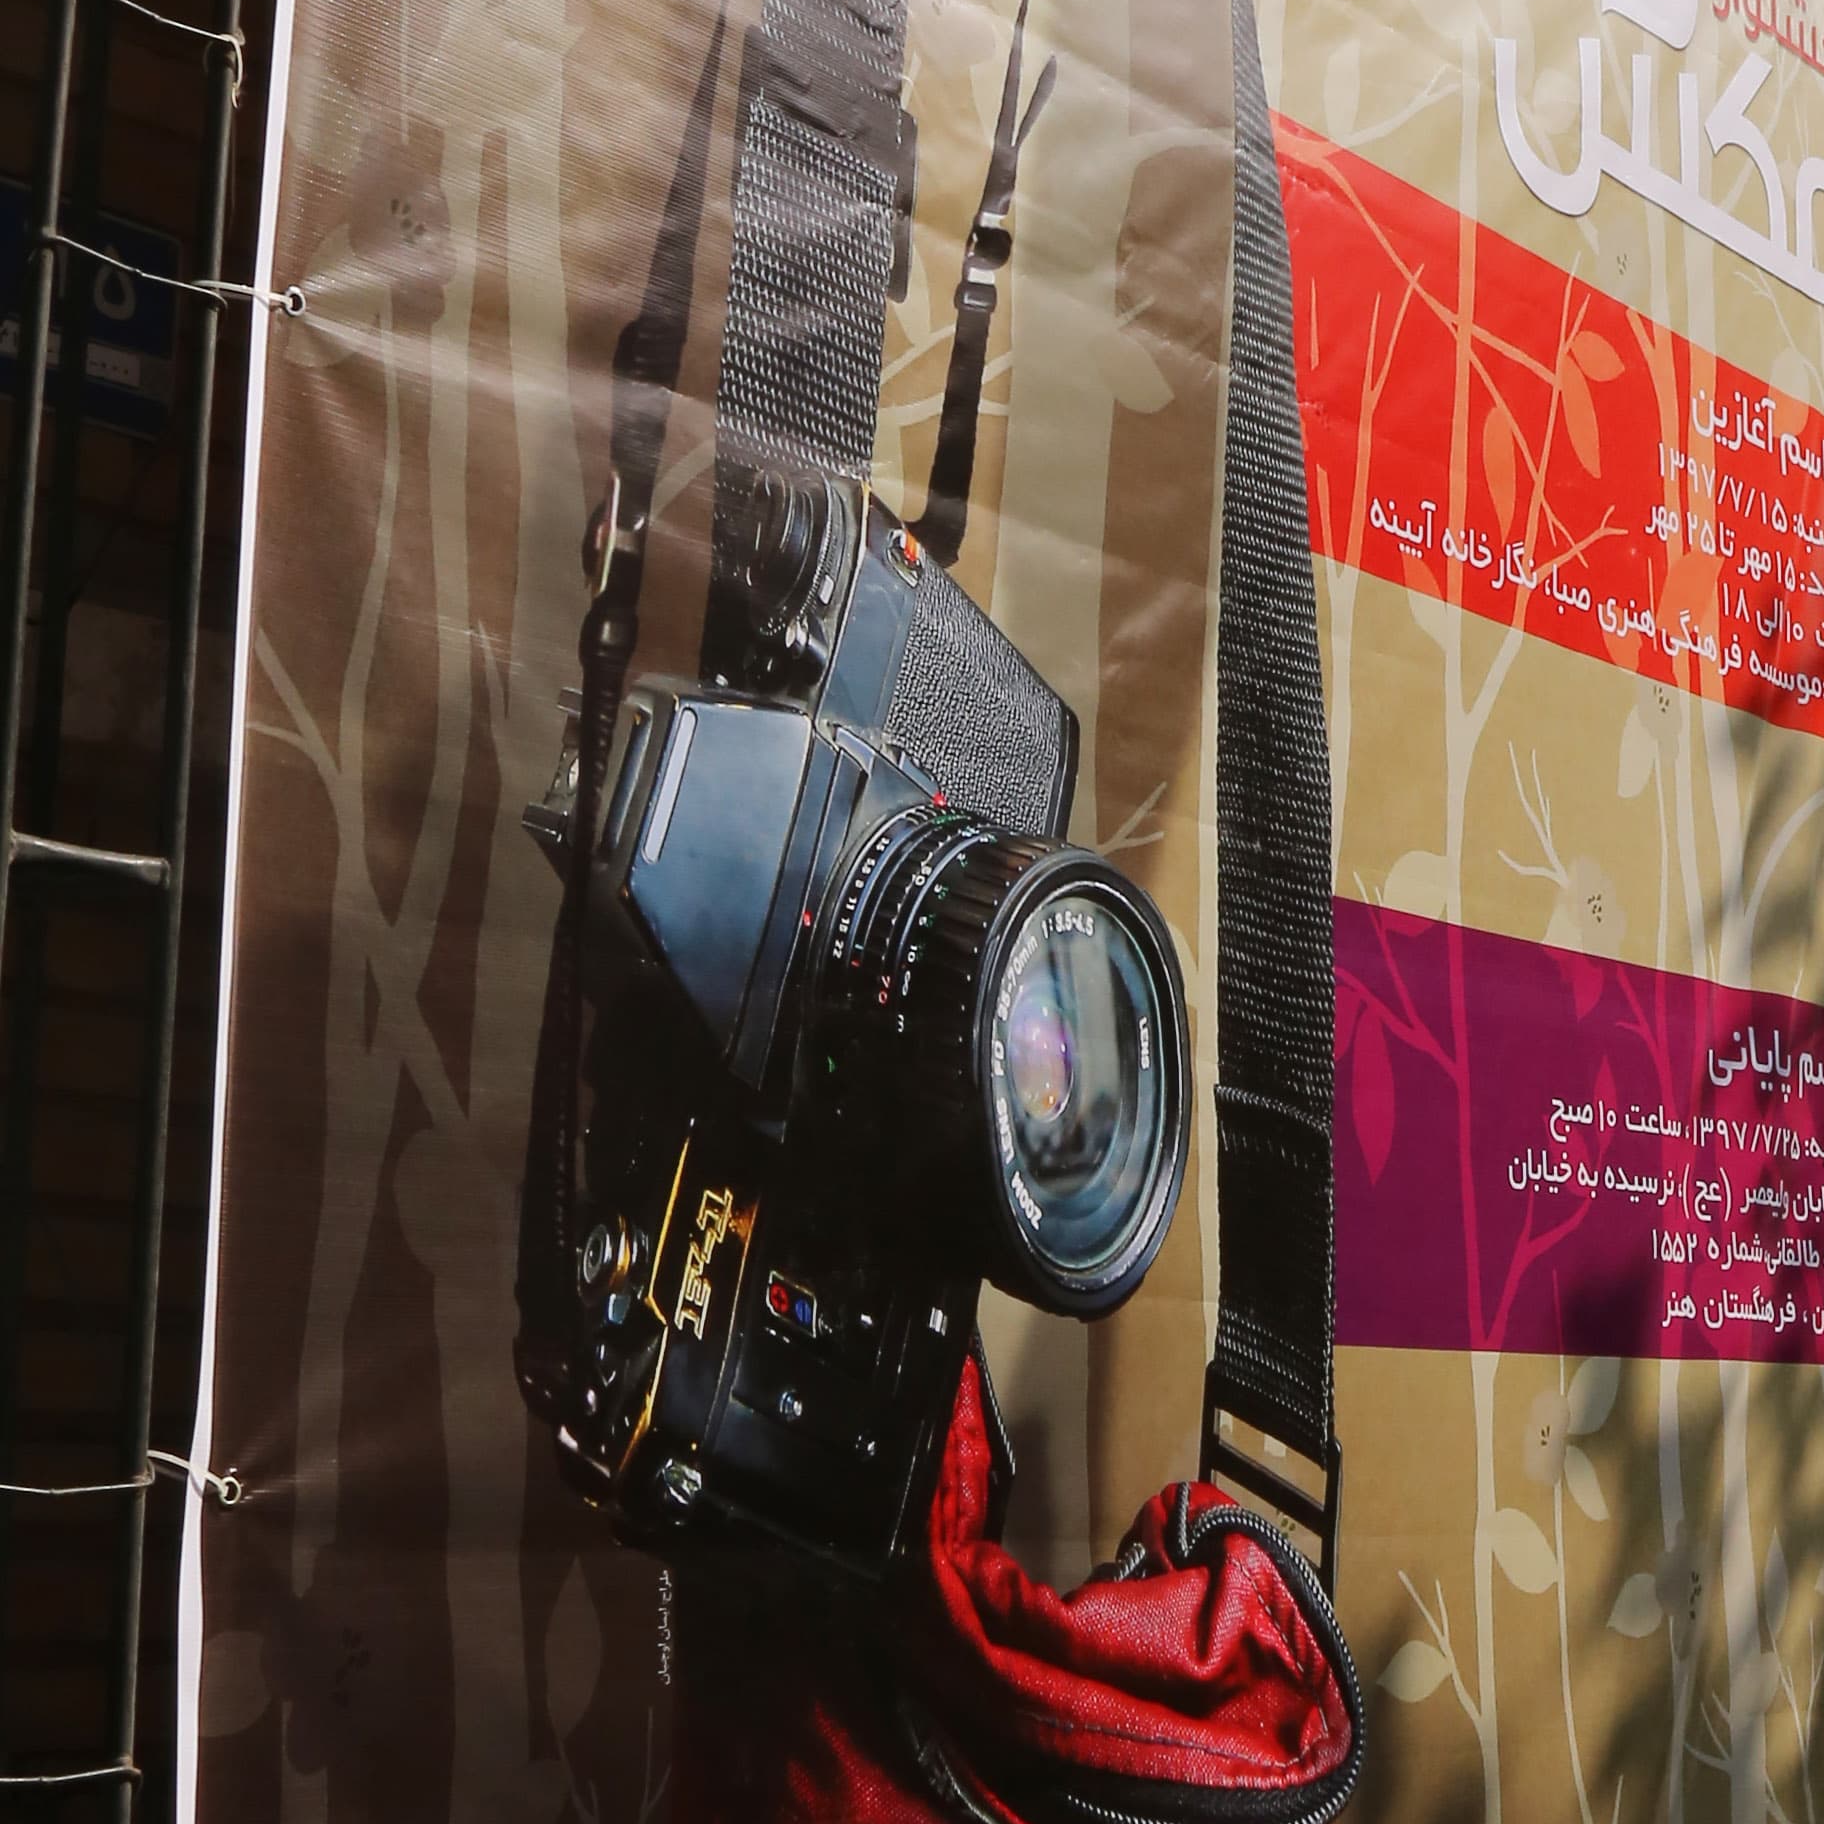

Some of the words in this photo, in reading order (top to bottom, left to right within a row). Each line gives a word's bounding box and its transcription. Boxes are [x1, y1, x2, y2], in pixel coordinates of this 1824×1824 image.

[1691, 388, 1776, 454] آغازین
[1597, 597, 1656, 639] هنری
[1722, 582, 1751, 624] ۱۸
[1662, 608, 1743, 676] فرهنگی
[1707, 1026, 1792, 1104] پایانی
[996, 1096, 1016, 1165] LENS
[1507, 1147, 1574, 1194] خیابان
[1576, 1160, 1600, 1199] به
[1011, 1170, 1042, 1230] ZOOM
[1651, 1228, 1699, 1264] ۱۵۵۲
[1661, 1290, 1697, 1328] هنر
[1702, 1285, 1797, 1332] فرهنگستان
